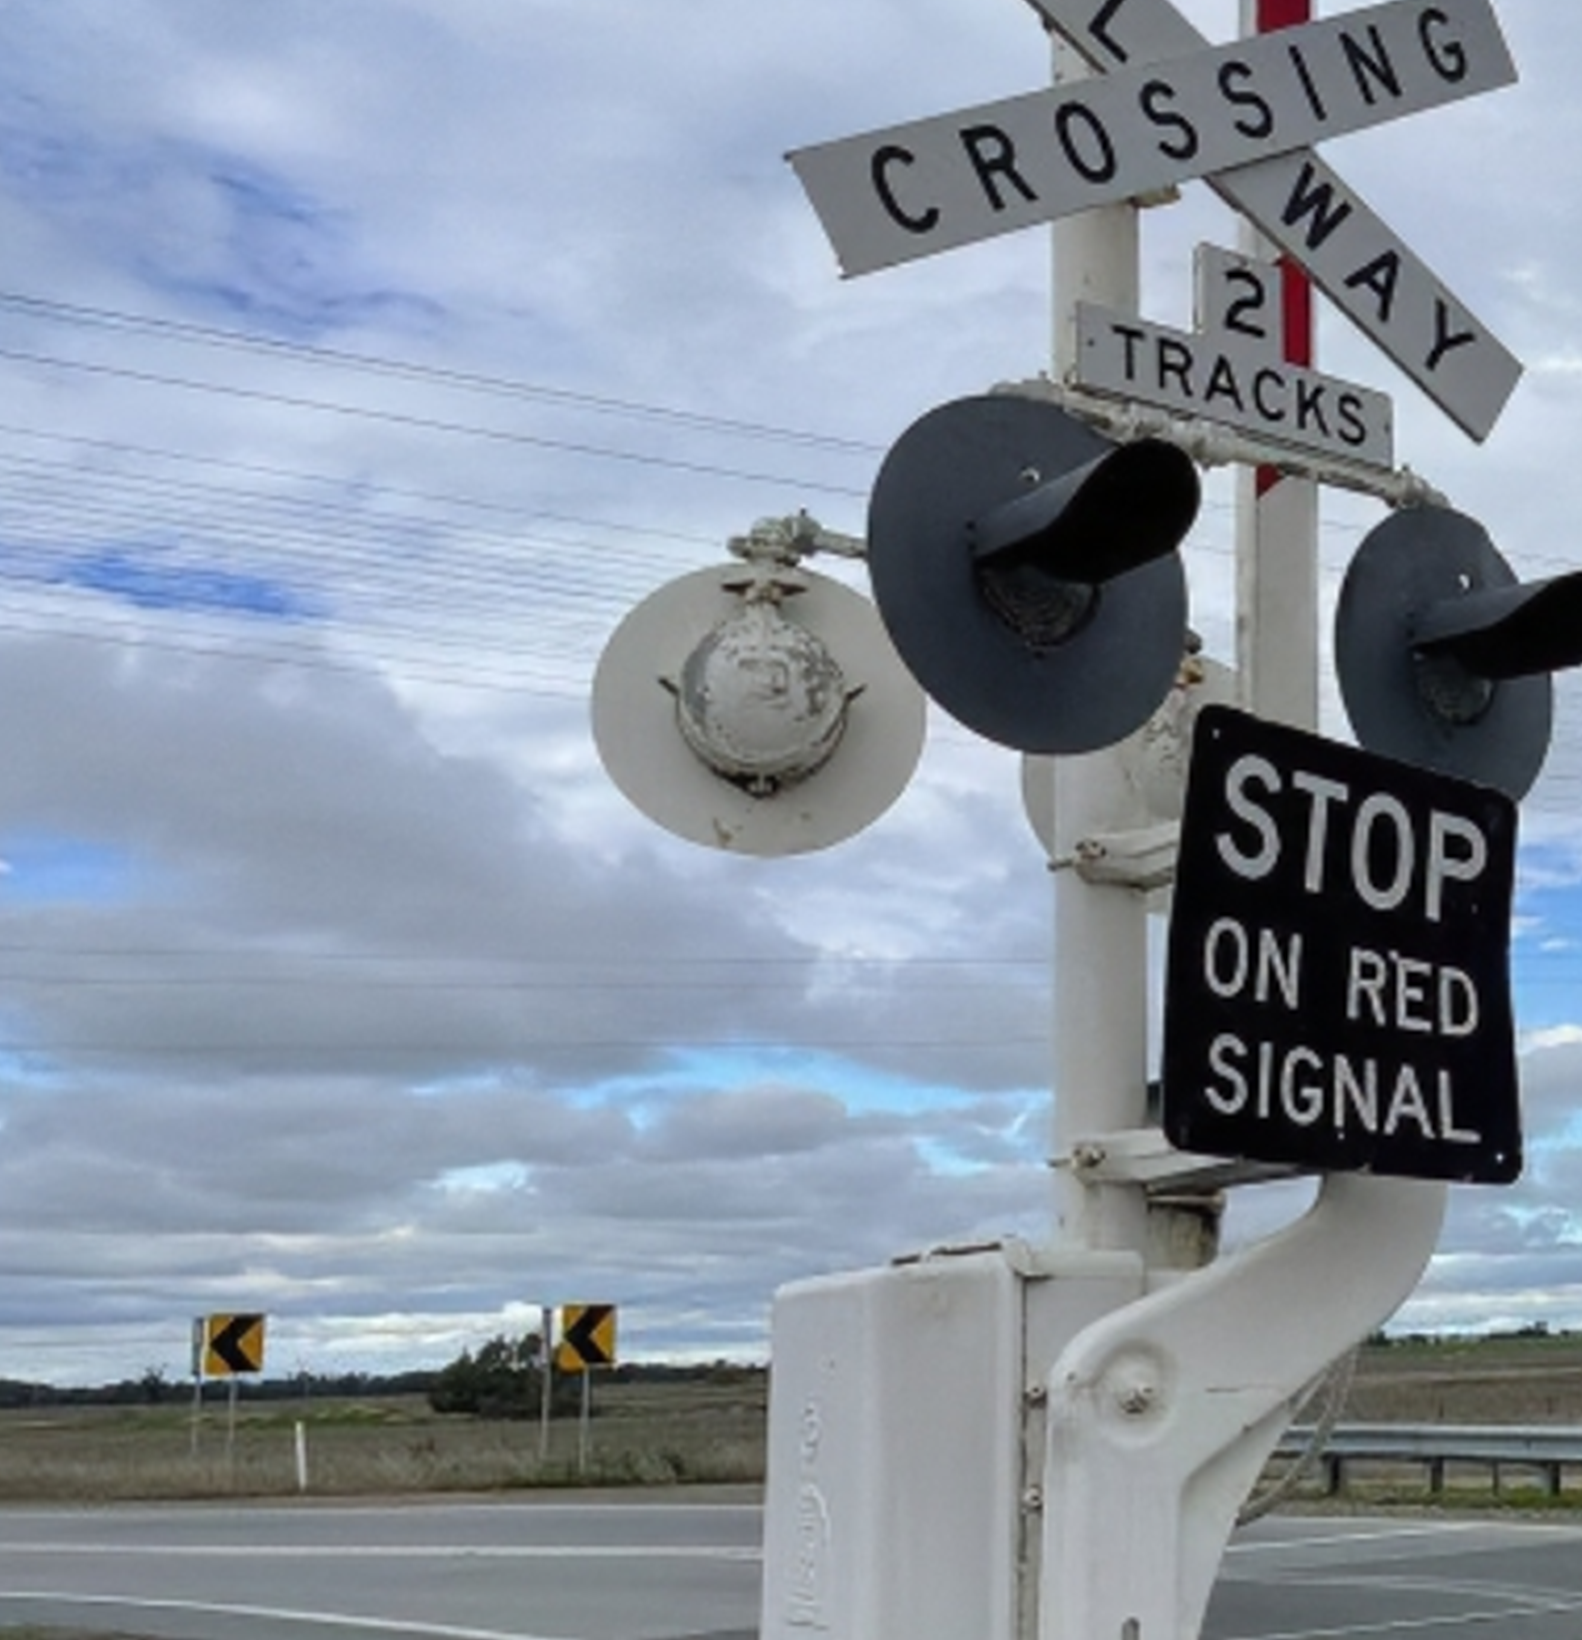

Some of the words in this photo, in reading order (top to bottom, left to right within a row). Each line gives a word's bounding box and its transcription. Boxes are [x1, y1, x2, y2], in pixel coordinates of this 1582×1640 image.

[872, 8, 1466, 233] CROSSING
[1224, 268, 1265, 338] 2
[1282, 162, 1475, 370] WAY
[1112, 325, 1366, 446] TRACKS
[1216, 754, 1485, 920] STOP
[1206, 919, 1301, 1008] ON
[1348, 948, 1477, 1035] RED
[1206, 1034, 1480, 1142] SIGNAL
